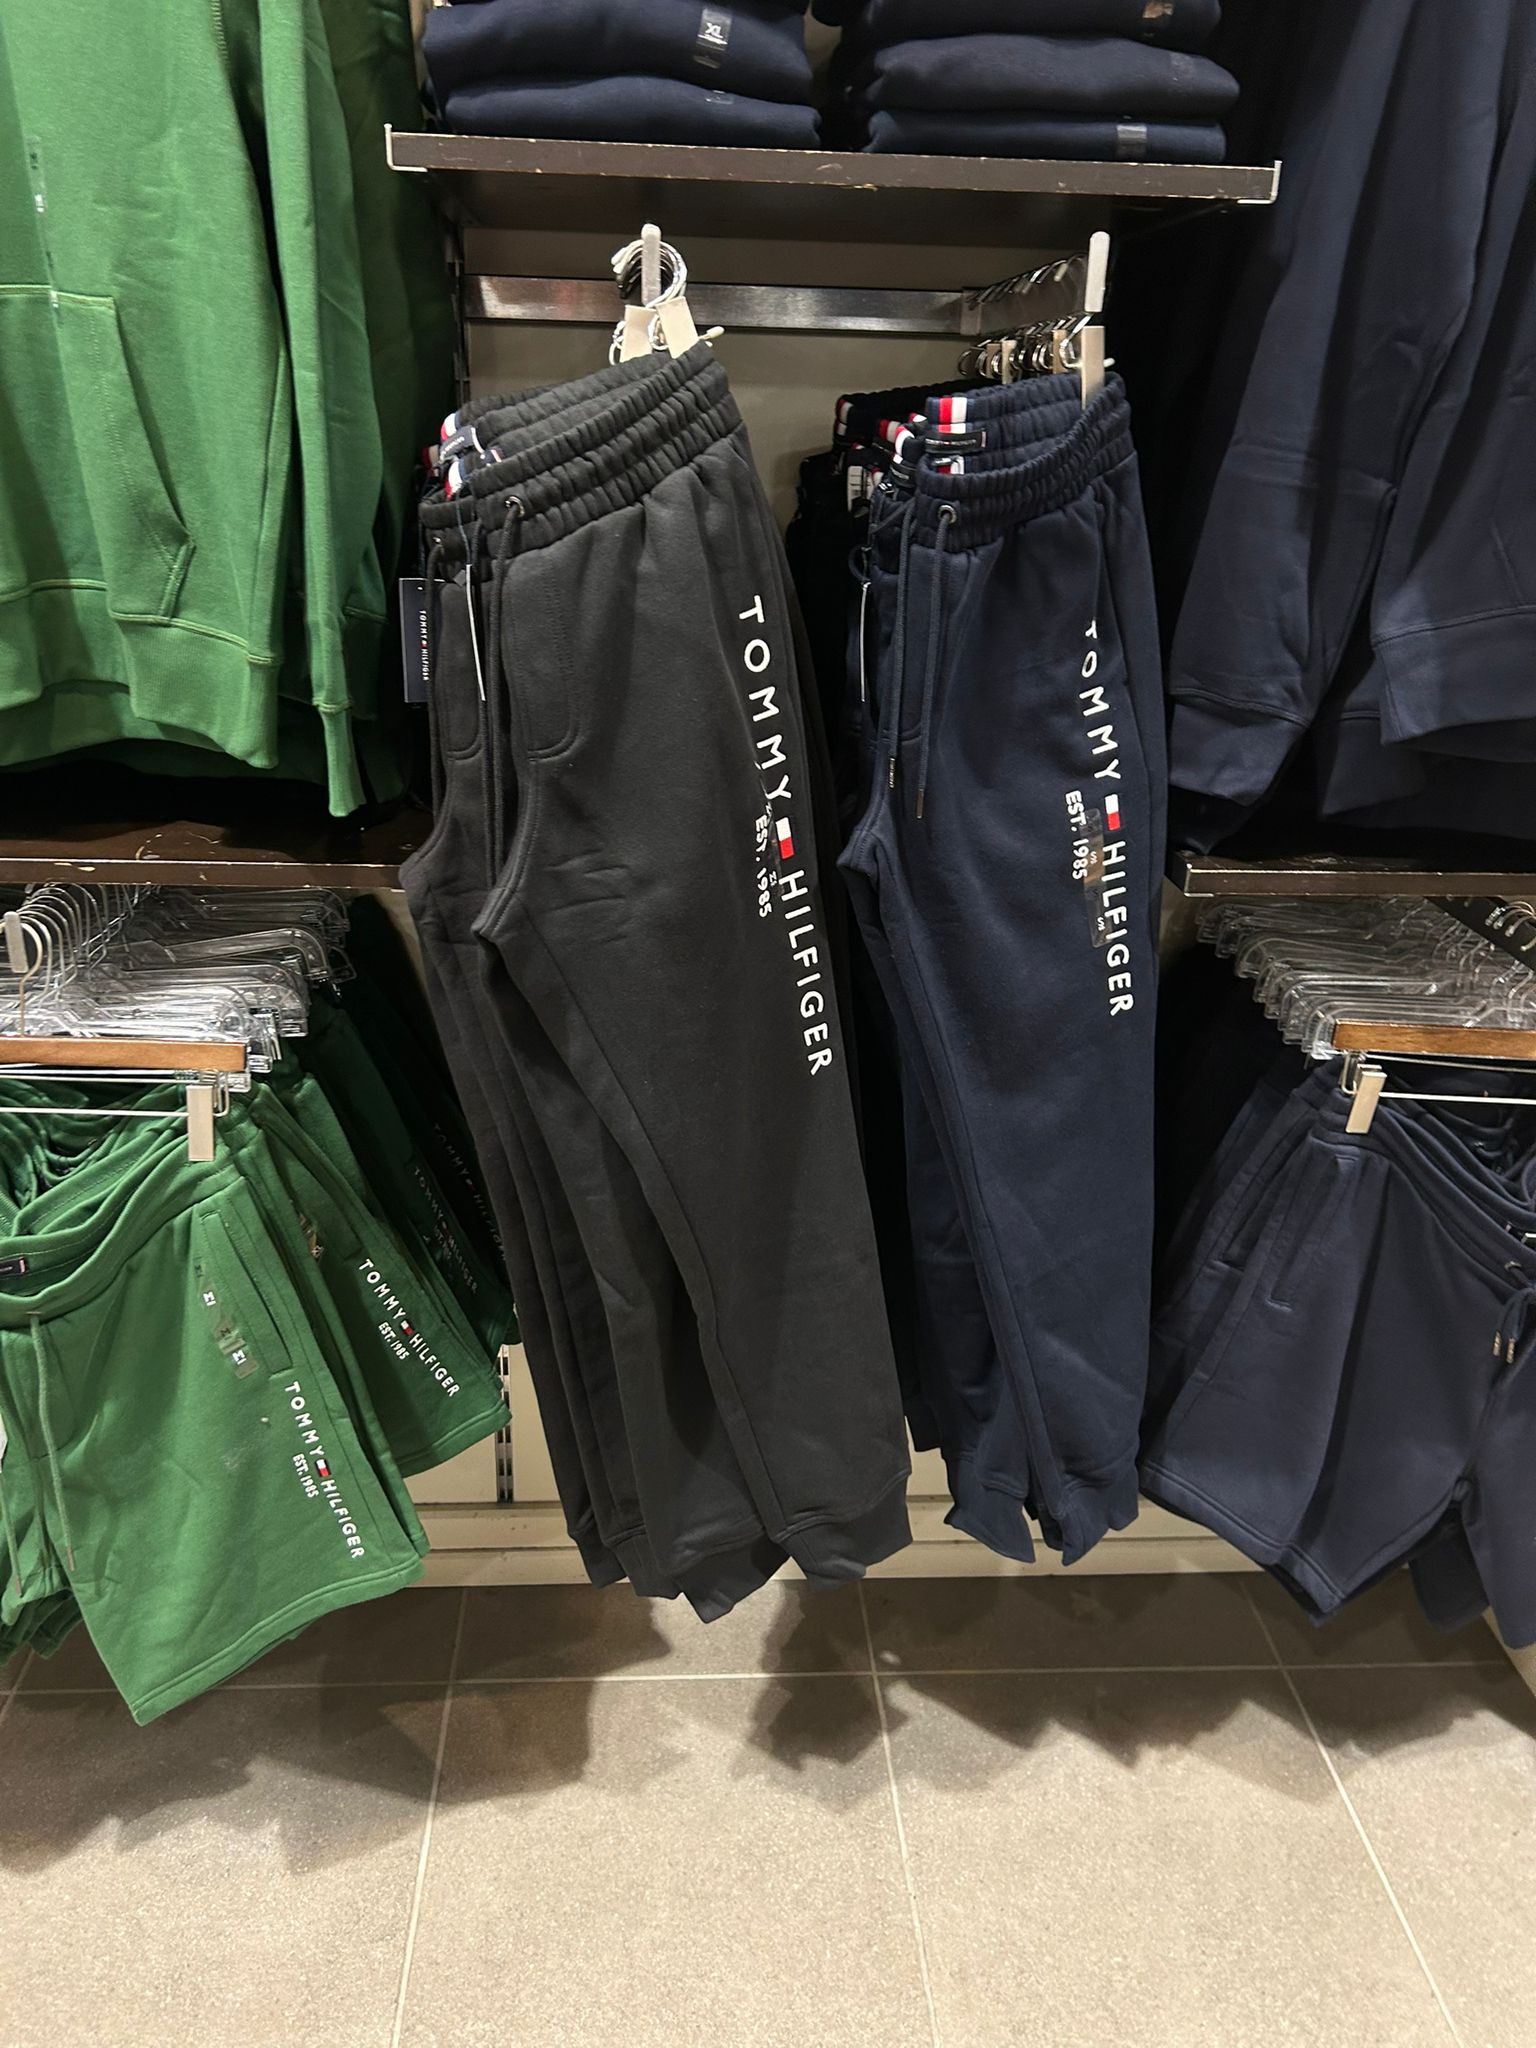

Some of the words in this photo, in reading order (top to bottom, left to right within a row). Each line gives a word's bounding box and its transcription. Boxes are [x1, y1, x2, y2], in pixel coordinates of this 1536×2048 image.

[739, 594, 792, 800] TOMMY
[778, 869, 833, 1076] HILFIGER
[1065, 790, 1087, 832] EST.
[1078, 619, 1122, 780] TOMMY
[1101, 840, 1134, 1017] HILFIGER
[755, 814, 770, 862] EST.
[1072, 838, 1090, 880] 1985
[756, 867, 772, 918] 1985
[358, 1258, 406, 1320] TOMMY
[409, 1333, 460, 1397] HILFIGER
[378, 1321, 396, 1342] EST.
[391, 1340, 410, 1360] 1985
[284, 1381, 325, 1456] TOMMY
[320, 1479, 365, 1559] HILFIGER
[292, 1453, 309, 1476] EST.
[300, 1475, 320, 1498] 1985
